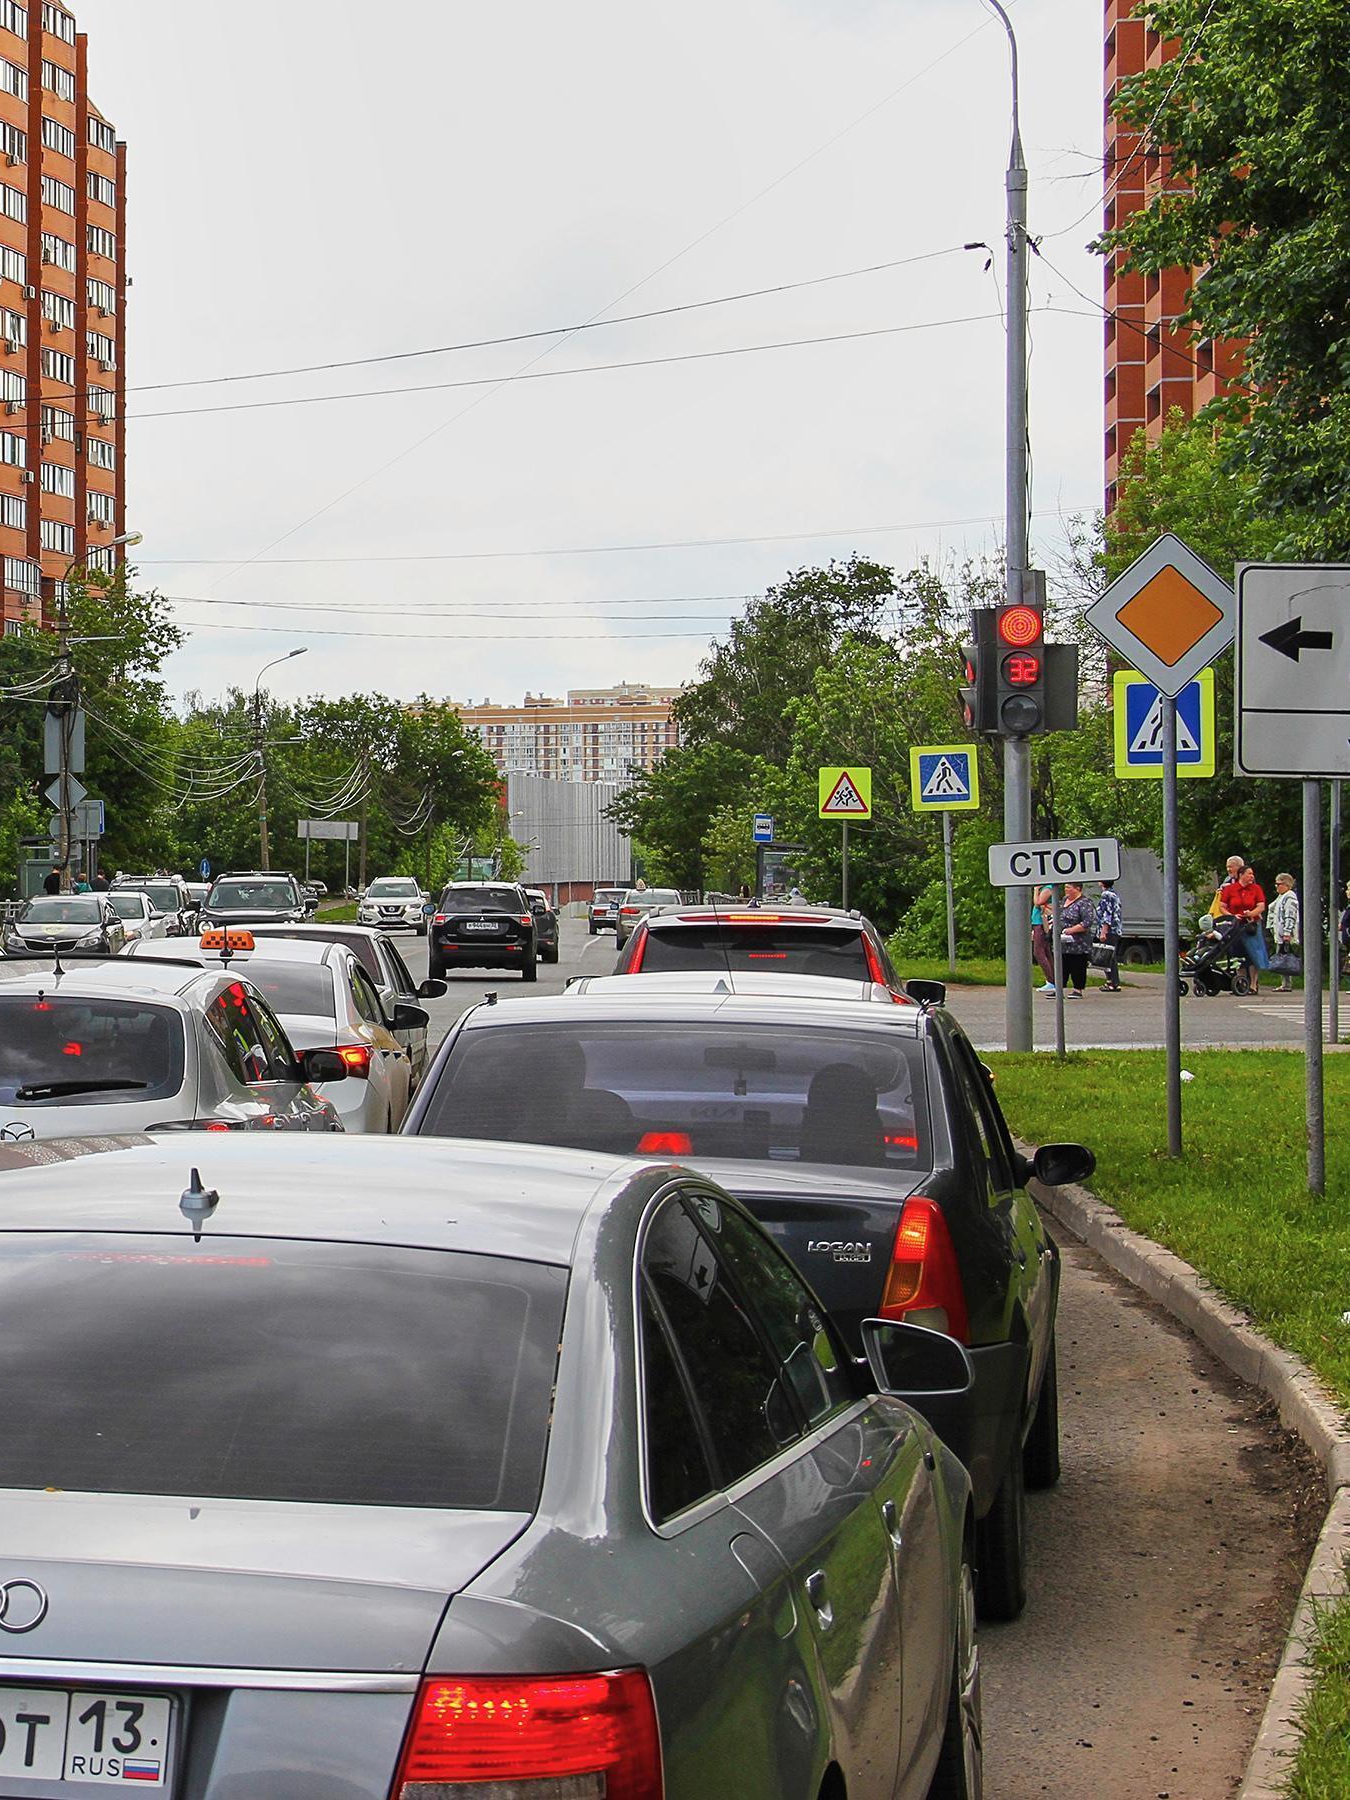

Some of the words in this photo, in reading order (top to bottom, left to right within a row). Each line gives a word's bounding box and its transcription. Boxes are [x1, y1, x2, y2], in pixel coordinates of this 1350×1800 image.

[1010, 658, 1038, 682] 32
[1010, 847, 1101, 877] СТОП
[808, 1240, 872, 1253] LOGAN
[79, 1700, 146, 1754] 13
[71, 1756, 121, 1777] RUS
